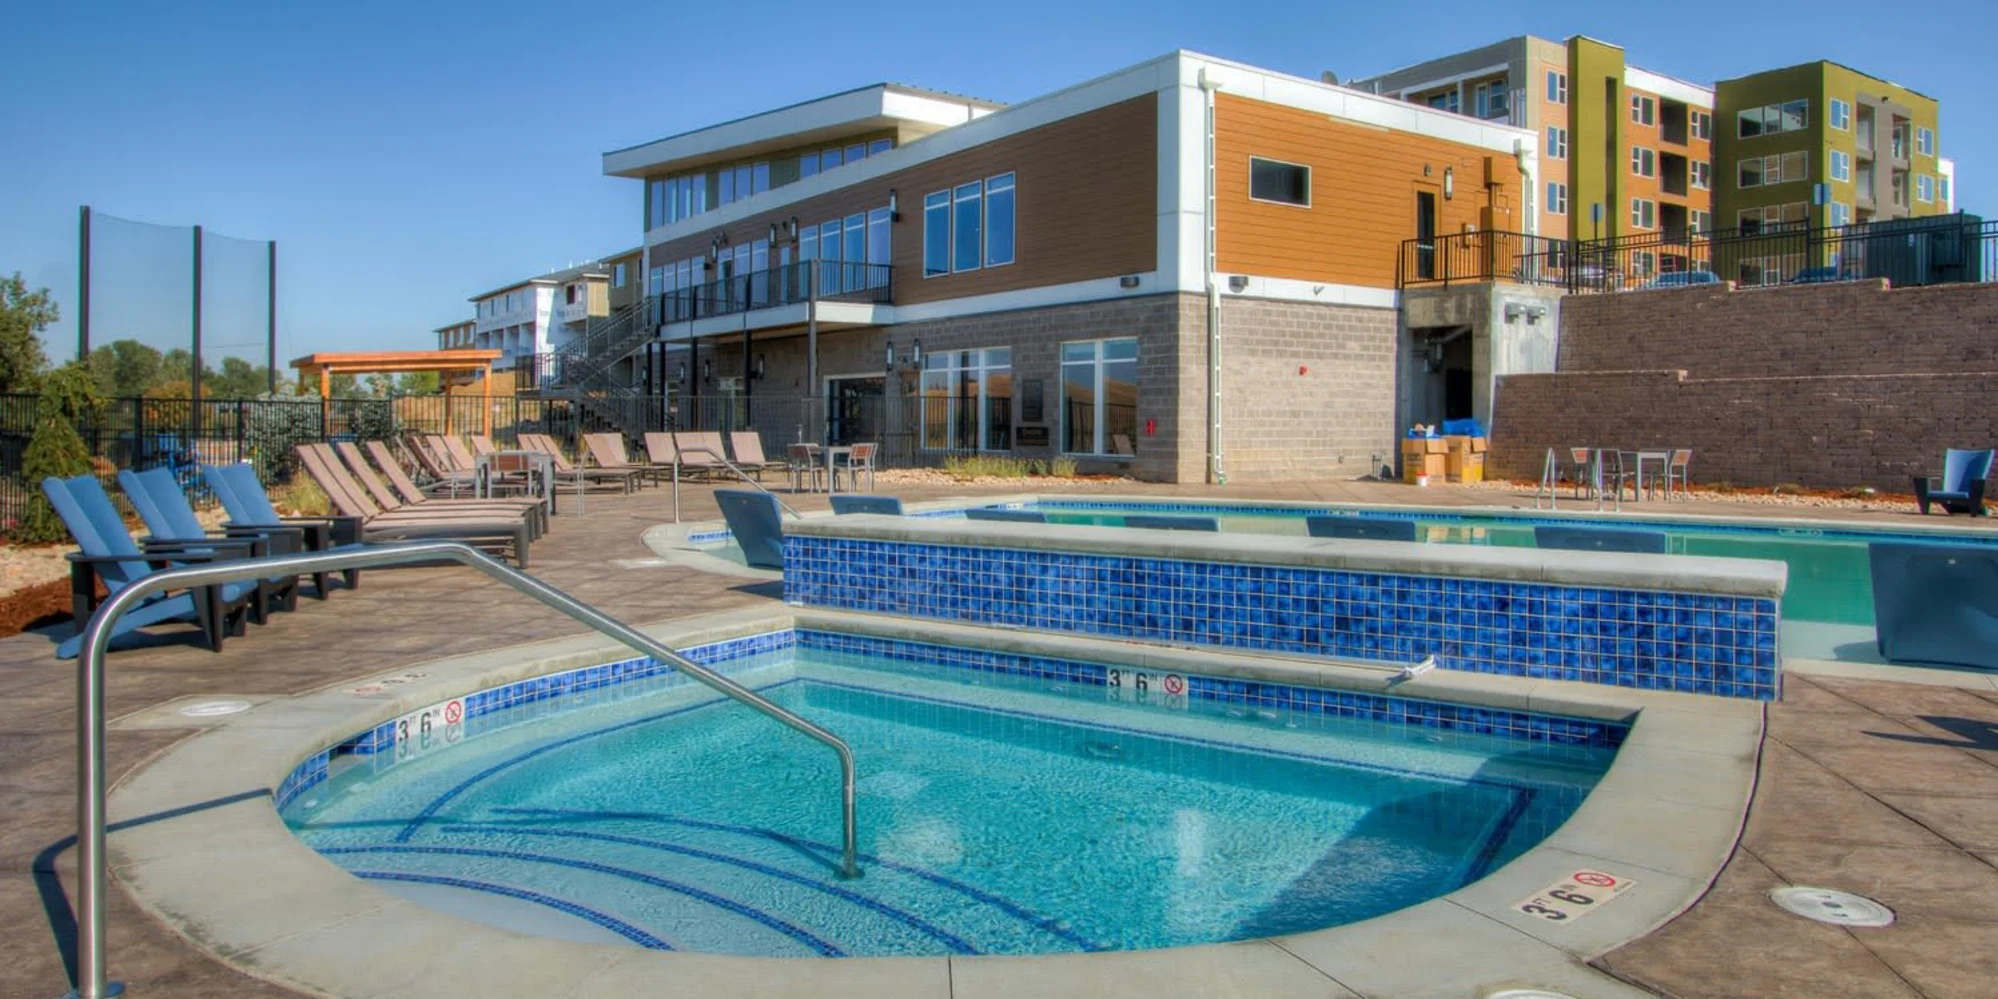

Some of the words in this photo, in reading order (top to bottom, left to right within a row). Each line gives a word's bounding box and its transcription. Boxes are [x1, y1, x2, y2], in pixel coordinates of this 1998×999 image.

[1109, 668, 1121, 687] 3
[1135, 672, 1148, 691] 6
[398, 719, 409, 743] 3
[420, 711, 432, 733] 6
[1521, 904, 1568, 920] 3
[1549, 890, 1594, 905] 6
